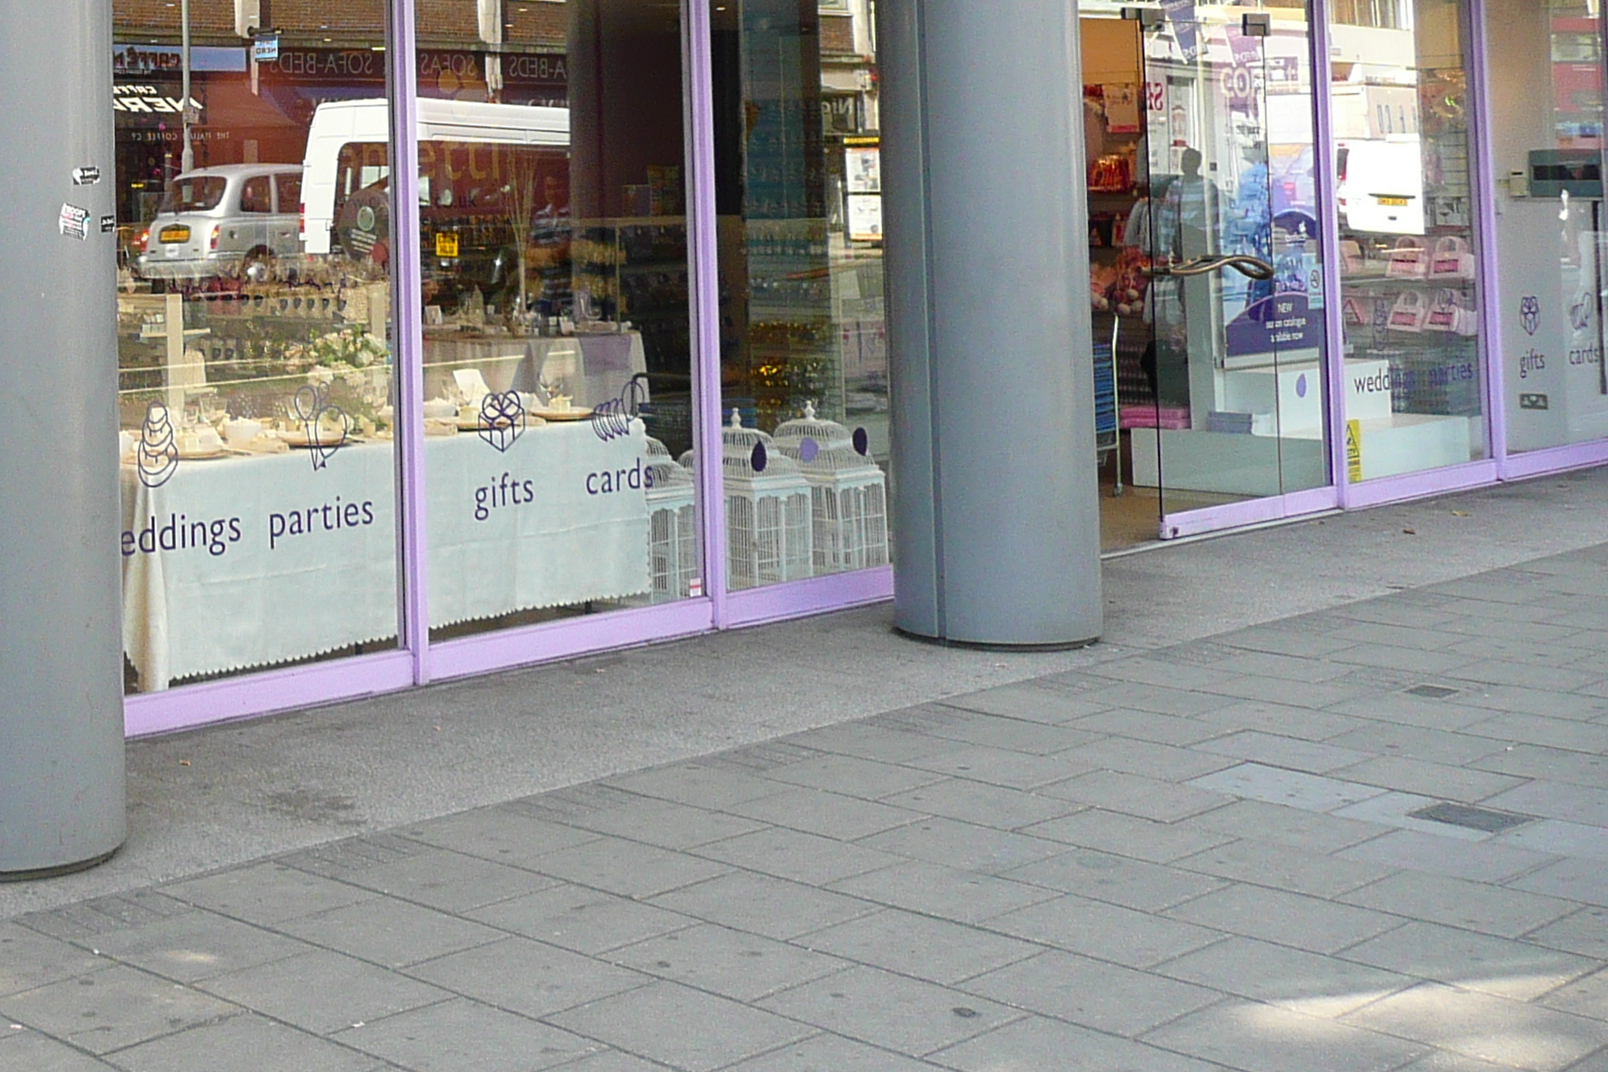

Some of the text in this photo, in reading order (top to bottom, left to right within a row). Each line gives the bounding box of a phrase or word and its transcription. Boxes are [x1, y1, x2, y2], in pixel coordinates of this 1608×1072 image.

[1519, 349, 1547, 379] gifts
[1569, 346, 1600, 366] cards
[121, 457, 654, 557] eddings parties gifts cards
